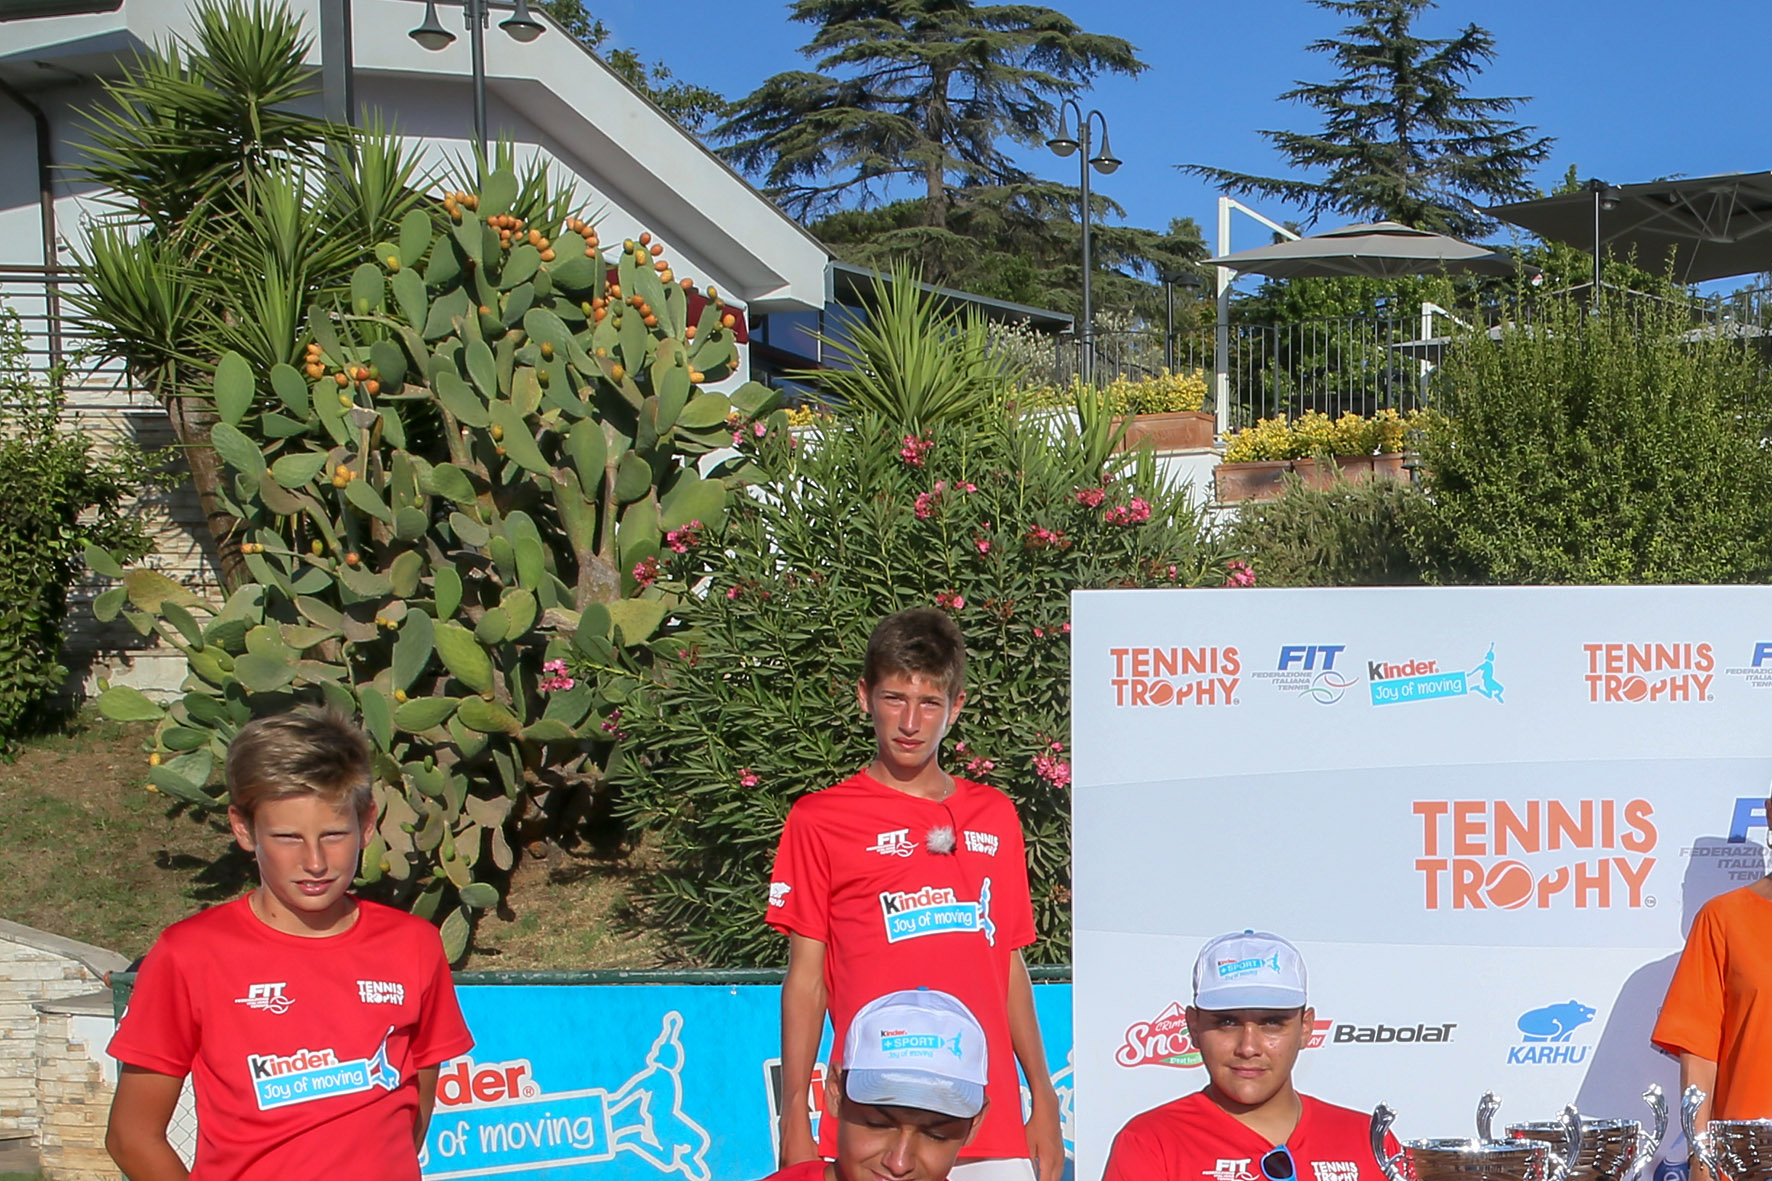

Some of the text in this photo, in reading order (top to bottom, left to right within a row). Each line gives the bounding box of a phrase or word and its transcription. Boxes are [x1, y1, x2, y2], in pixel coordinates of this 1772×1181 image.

[1110, 647, 1241, 677] TENNIS
[1277, 645, 1346, 670] FIT
[1368, 659, 1436, 681] Kinder
[1583, 643, 1715, 673] TENNIS
[1111, 678, 1240, 706] TROPHY
[1375, 677, 1462, 701] Joy of moving
[1585, 674, 1714, 702] TROPHY
[877, 828, 910, 846] FIT
[963, 830, 999, 845] TENNIS
[1413, 799, 1658, 856] TENNIS
[1415, 858, 1657, 910] TROPHY
[1728, 871, 1765, 880] TEN
[883, 889, 952, 915] Kinder
[893, 909, 972, 933] Joy of moving
[249, 982, 287, 998] FIT
[356, 980, 404, 995] TENNIS
[358, 991, 404, 1005] TROPHY
[1118, 1024, 1198, 1064] Sno
[1506, 1046, 1588, 1064] KARHU
[251, 1052, 332, 1079] Kinder
[264, 1070, 363, 1099] Joy of moving
[436, 1062, 526, 1106] der
[479, 1112, 595, 1153] moving
[1215, 1158, 1252, 1172] FIT
[1311, 1161, 1357, 1173] TENNIS
